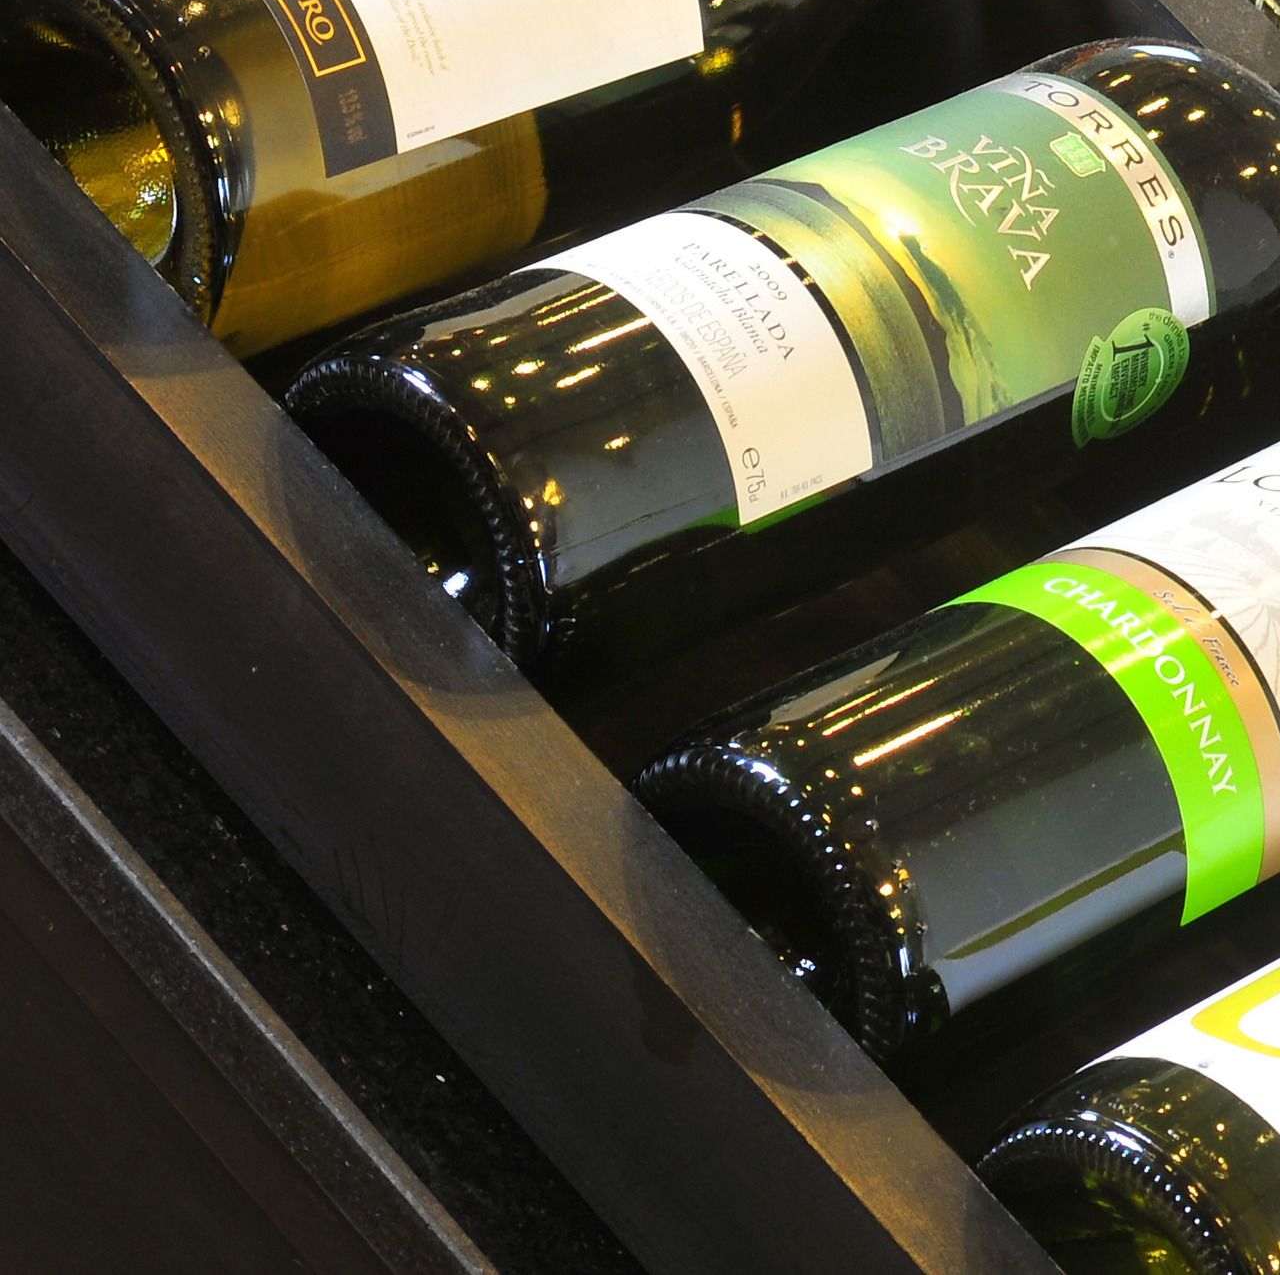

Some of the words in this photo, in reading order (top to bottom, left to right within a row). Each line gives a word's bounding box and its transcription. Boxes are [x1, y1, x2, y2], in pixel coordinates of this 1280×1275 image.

[900, 135, 1052, 292] BRAVA
[971, 134, 1061, 236] VIÑA
[1022, 79, 1185, 248] TORRES
[680, 241, 796, 363] PARELLADA
[730, 306, 770, 356] Blanca
[746, 262, 789, 303] 2009
[696, 319, 749, 381] ESPAÑA
[1042, 577, 1238, 796] CHARDONNAY
